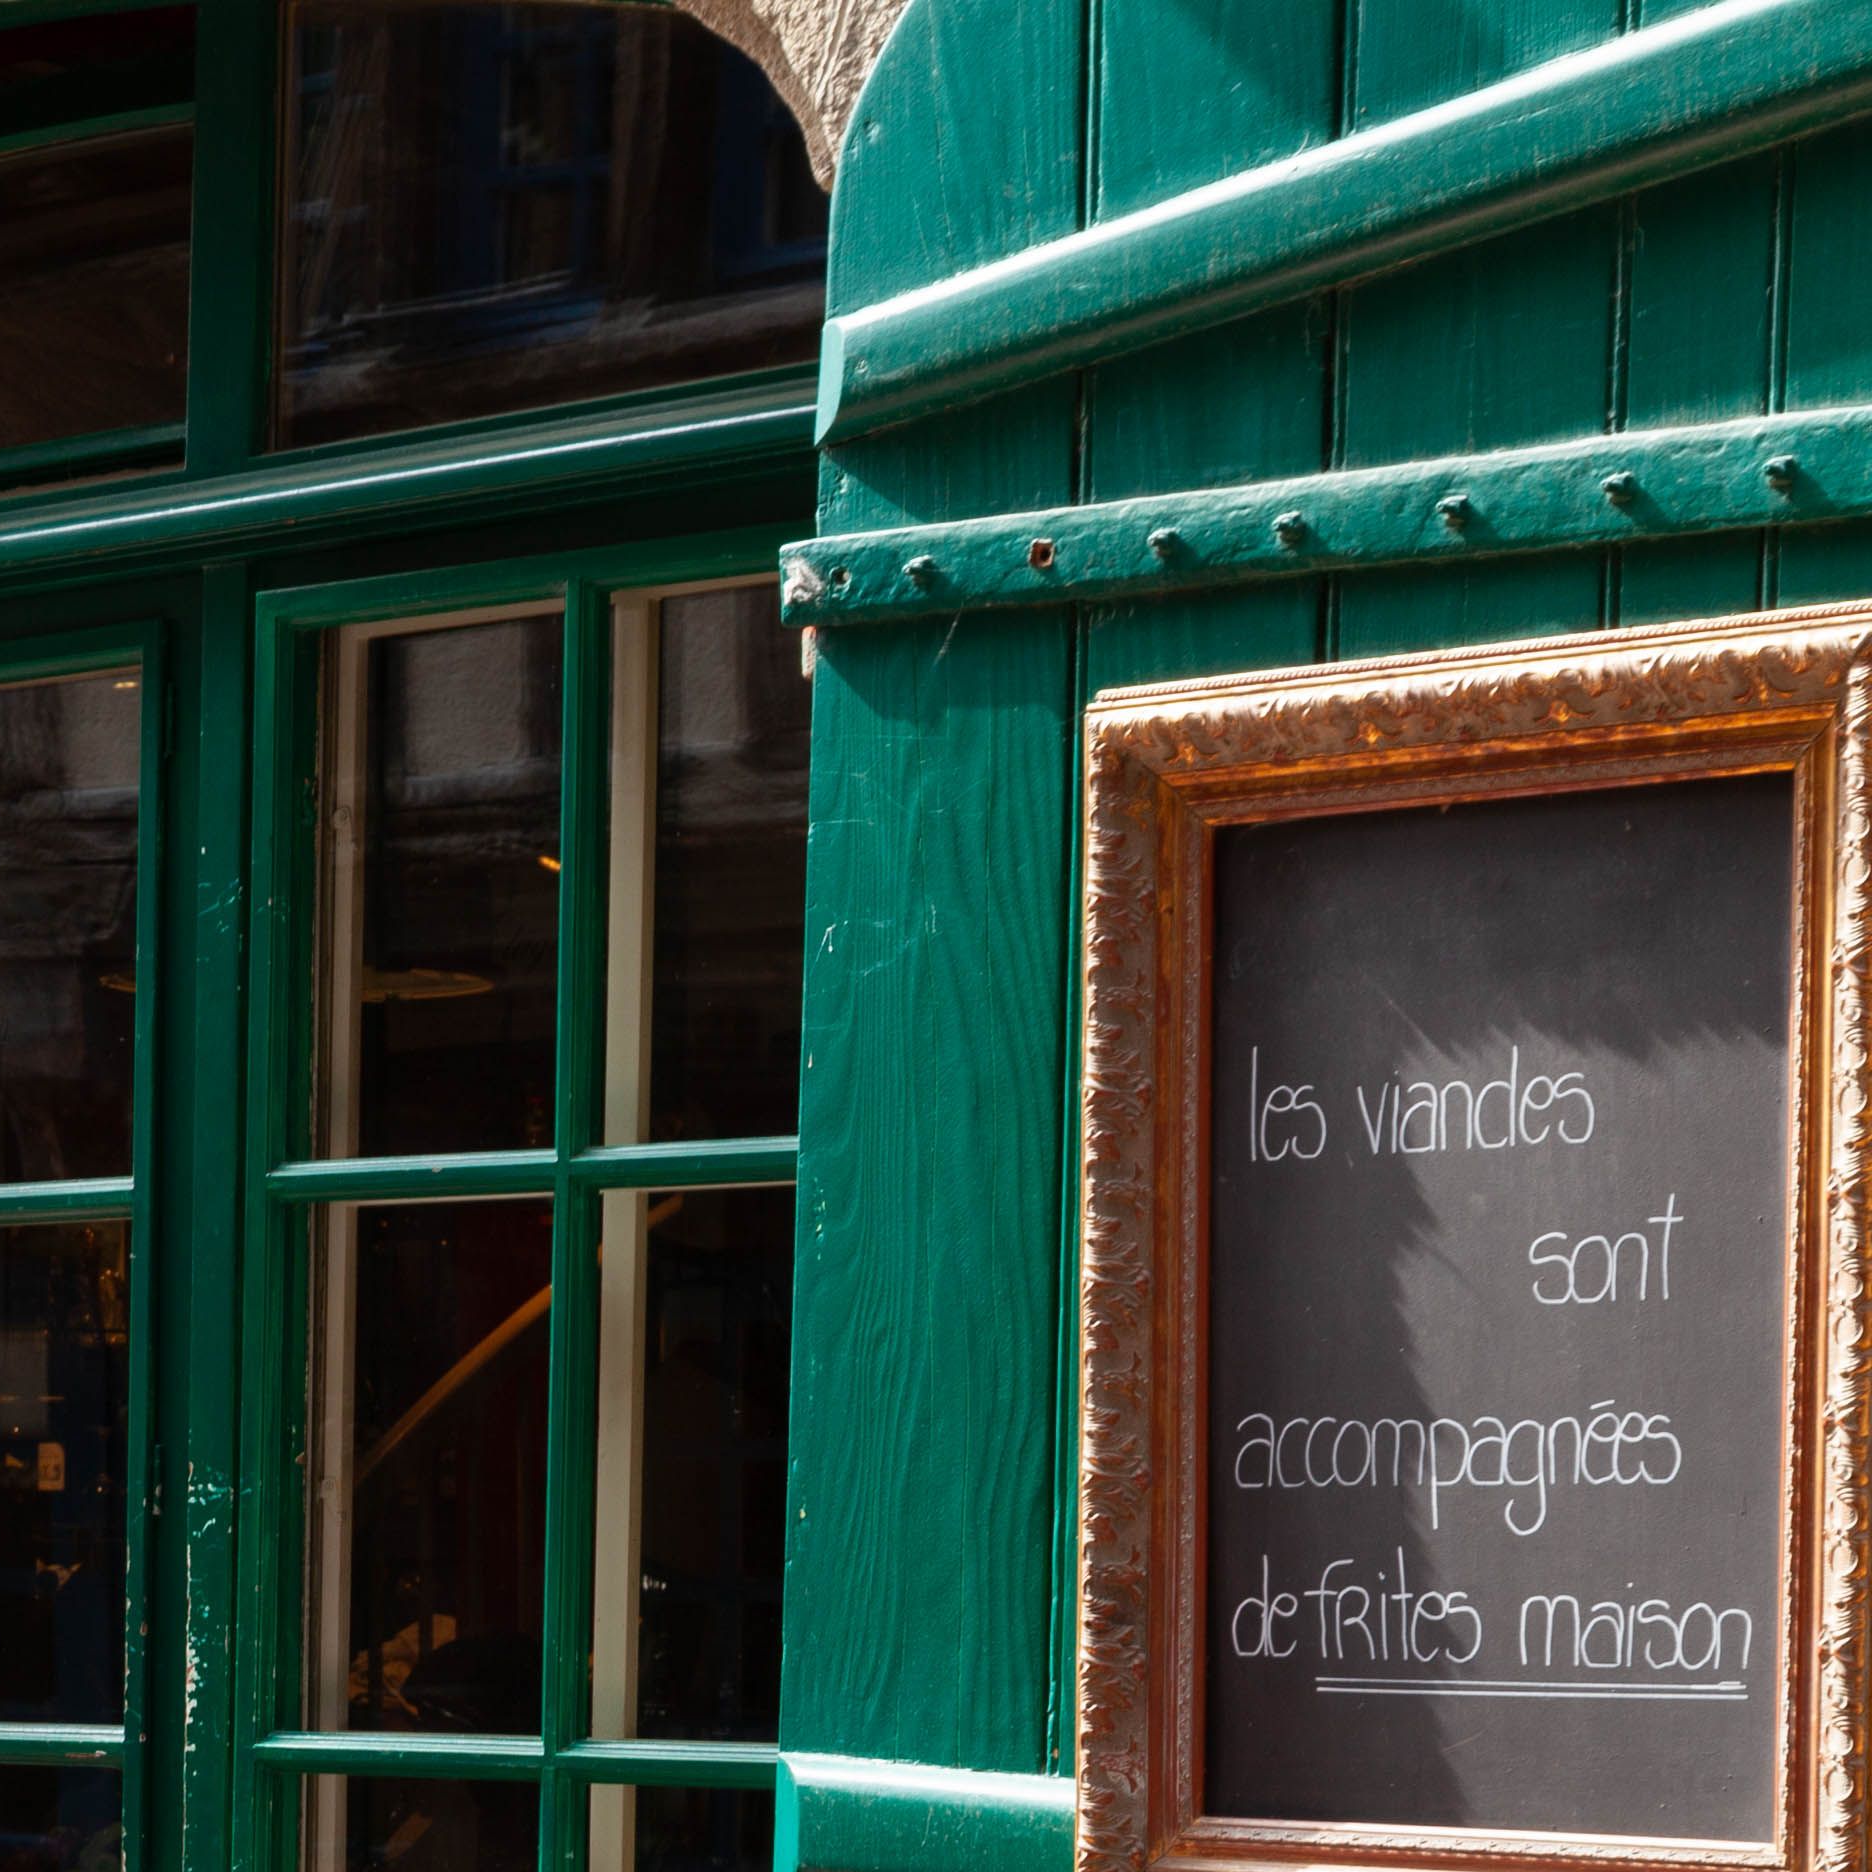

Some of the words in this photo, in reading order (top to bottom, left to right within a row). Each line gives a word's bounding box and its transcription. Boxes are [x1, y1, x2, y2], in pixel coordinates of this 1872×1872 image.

[1251, 1045, 1327, 1163] les
[1356, 1044, 1596, 1156] viandes
[1528, 1192, 1685, 1305] sont
[1233, 1399, 1682, 1537] accompagnées
[1230, 1553, 1298, 1660] de
[1519, 1581, 1753, 1671] maison
